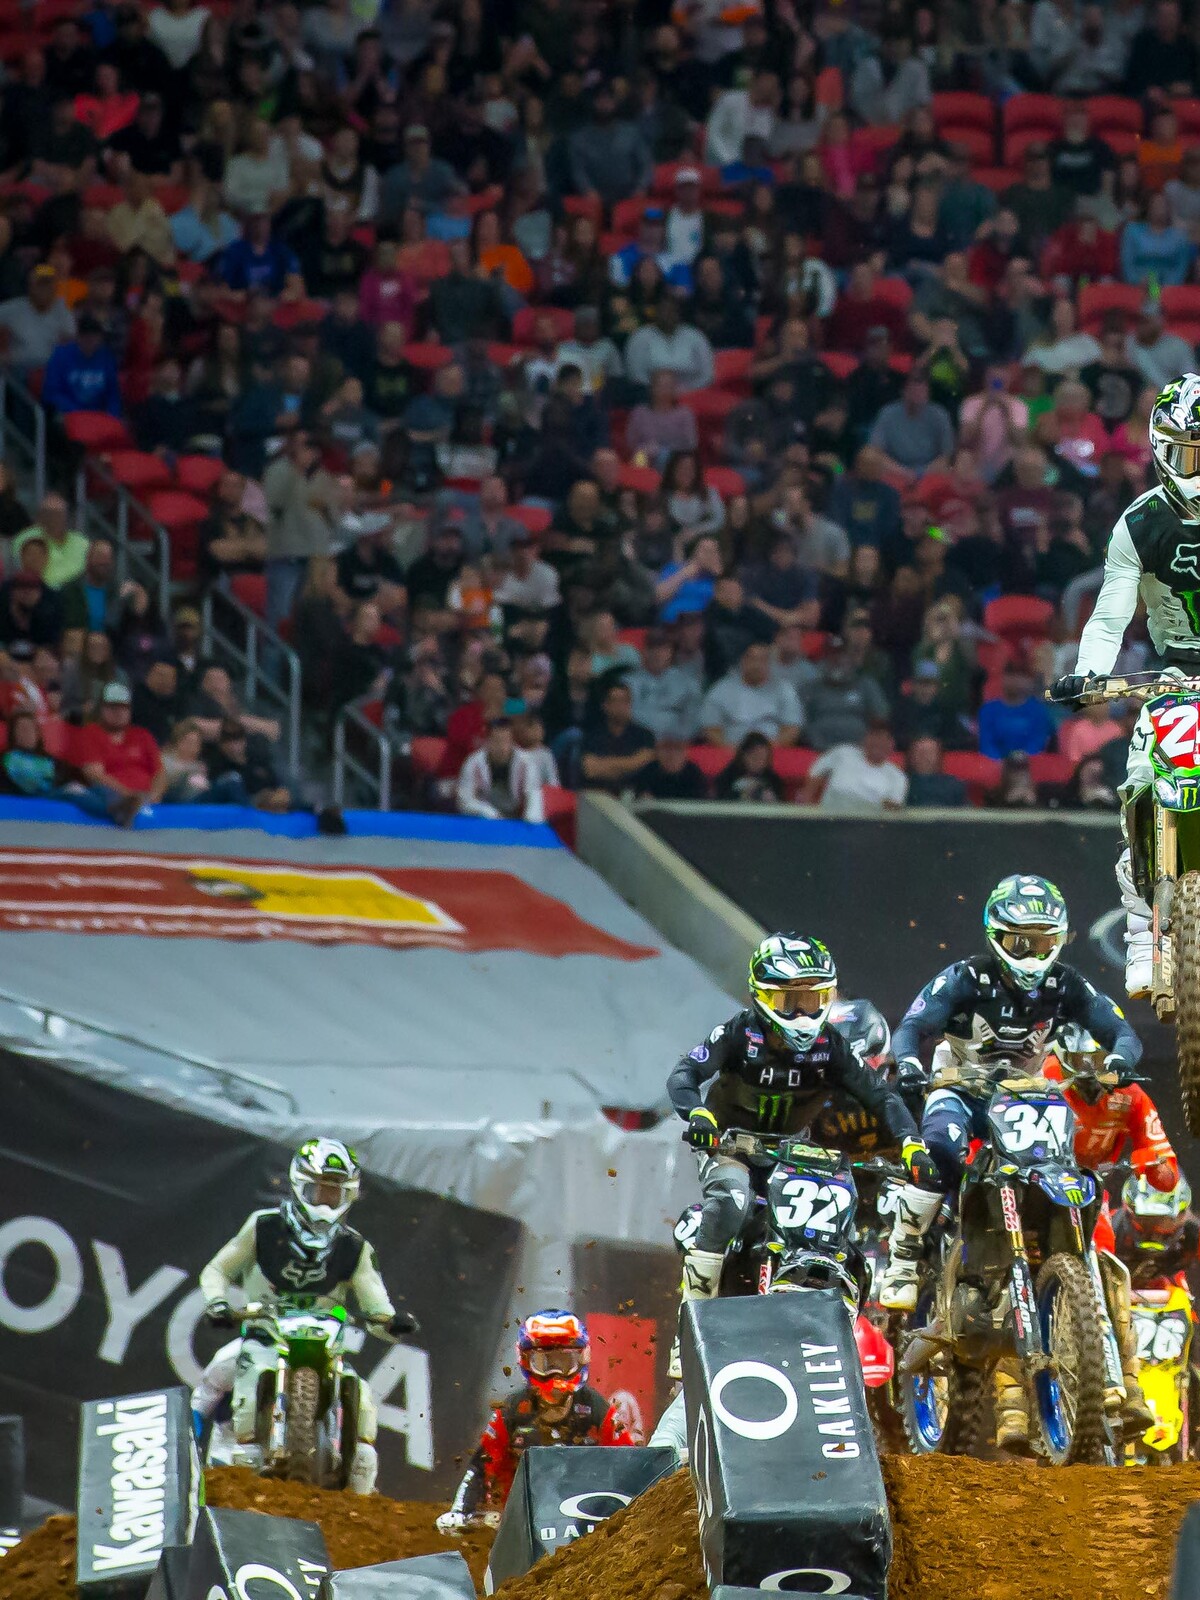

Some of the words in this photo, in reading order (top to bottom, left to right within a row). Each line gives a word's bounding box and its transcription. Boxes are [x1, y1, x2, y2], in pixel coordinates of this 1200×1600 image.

[1002, 1103, 1067, 1156] 34
[775, 1179, 852, 1233] 32
[0, 1215, 434, 1472] OYOA
[1133, 1318, 1187, 1361] 26
[800, 1342, 860, 1460] OAKLEY
[91, 1394, 169, 1572] Kawasaki
